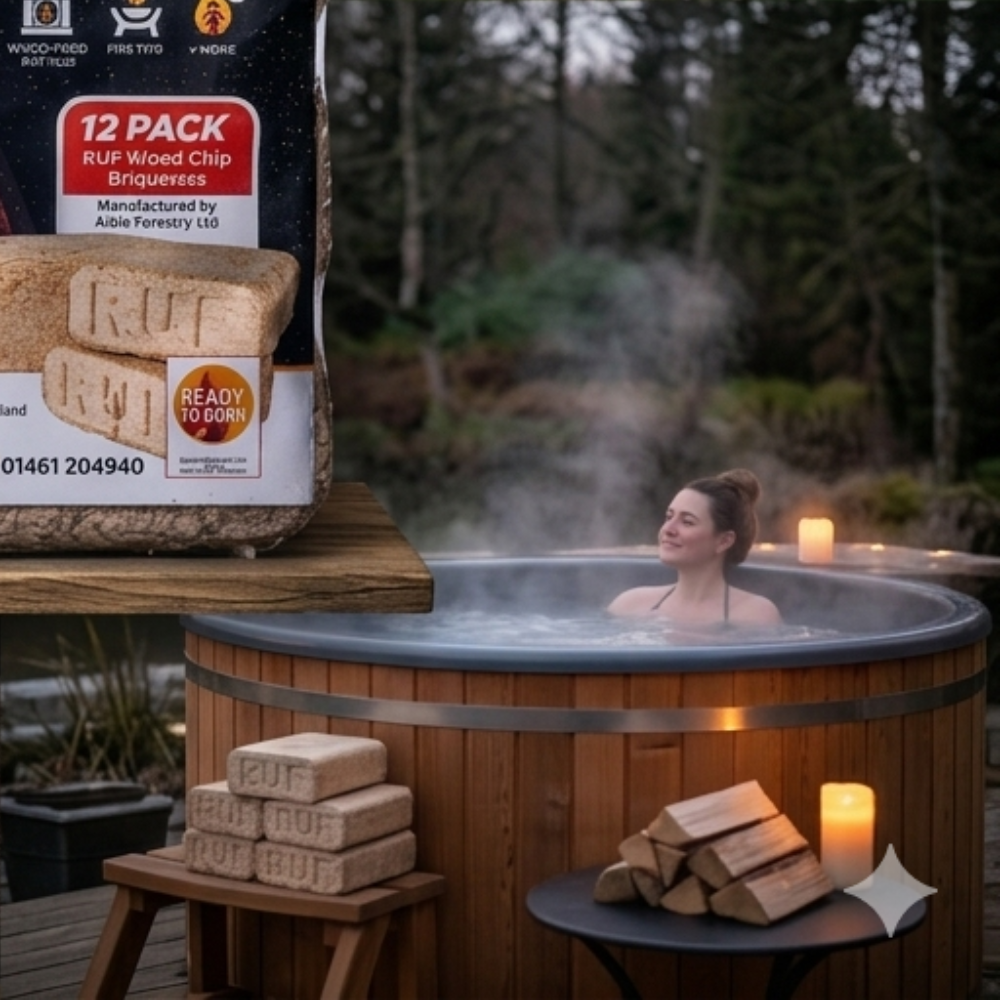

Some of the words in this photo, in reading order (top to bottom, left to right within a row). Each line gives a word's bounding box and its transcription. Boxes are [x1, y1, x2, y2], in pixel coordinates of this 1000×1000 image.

[81, 114, 120, 142] 12
[126, 114, 230, 142] PACK
[83, 151, 121, 165] RUF
[189, 150, 231, 169] Chip
[200, 200, 217, 214] by
[134, 216, 191, 230] Forestry
[180, 408, 201, 422] TO
[1, 457, 58, 475] 01461
[66, 457, 144, 475] 204940
